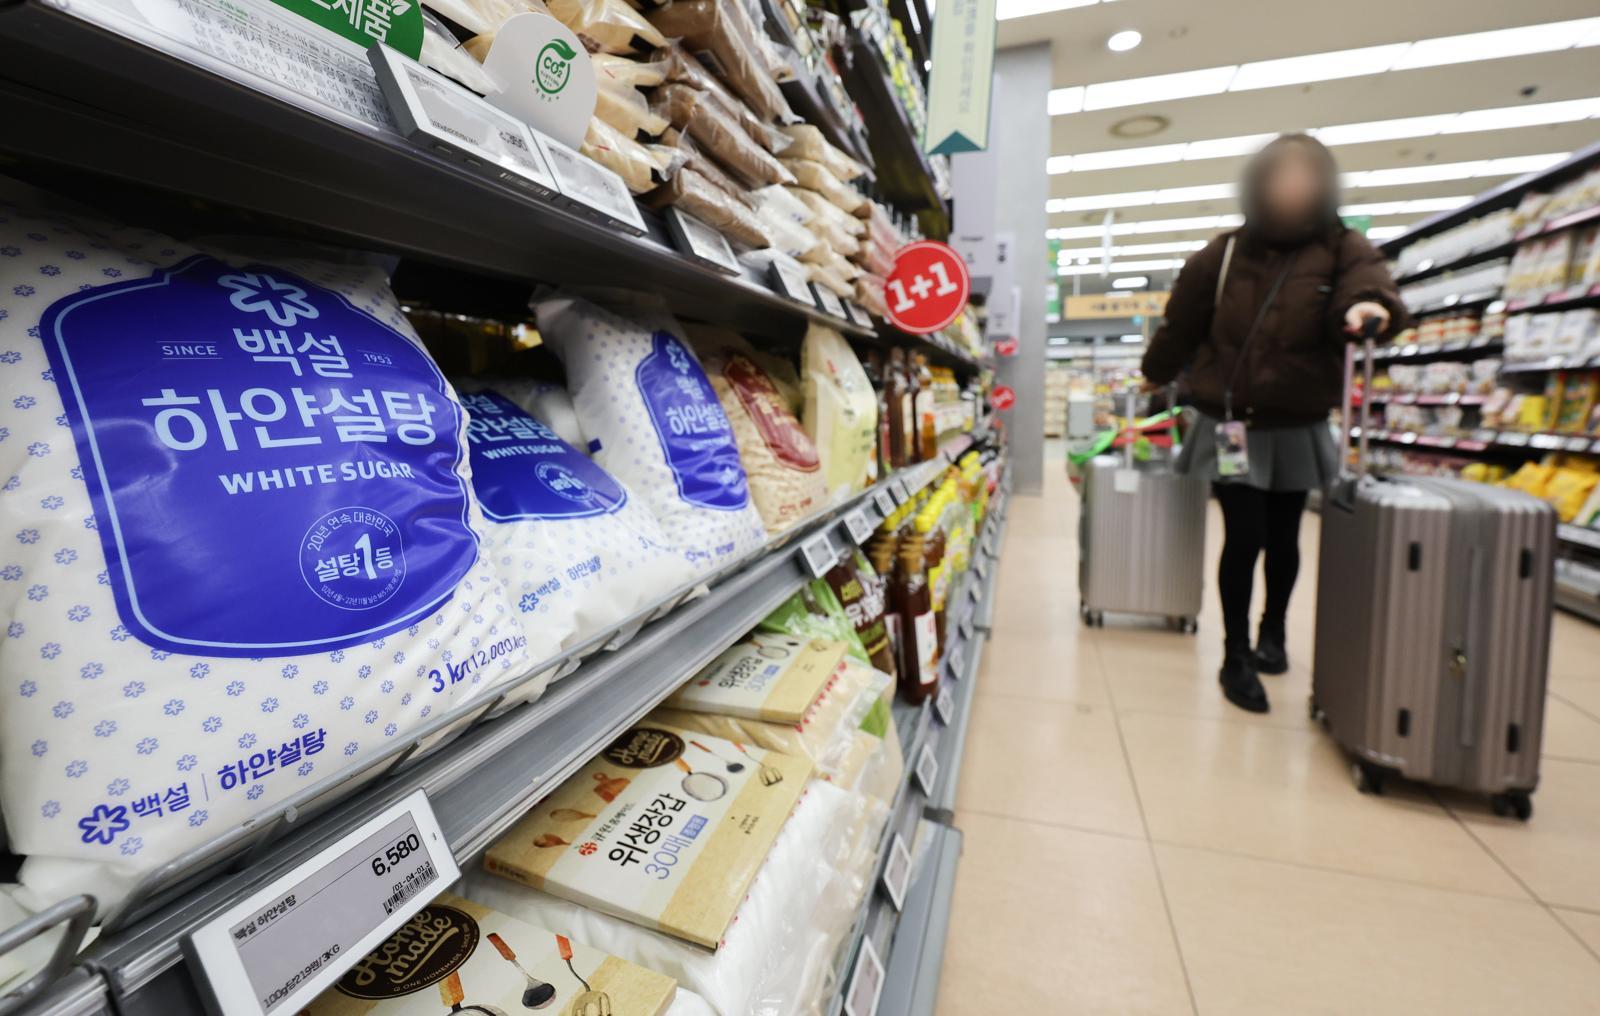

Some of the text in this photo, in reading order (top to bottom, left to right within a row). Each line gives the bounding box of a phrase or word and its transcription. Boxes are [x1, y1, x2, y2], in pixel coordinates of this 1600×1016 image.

[309, 0, 392, 43] 제품
[888, 261, 958, 313] 1+1
[162, 345, 392, 365] SINCE 1953
[232, 328, 354, 378] 백설
[142, 387, 436, 451] 하얀설탕
[219, 461, 415, 495] WHITE SUGAR
[307, 511, 394, 552] 20년 연속 대한민국
[428, 669, 445, 693] 3
[132, 728, 327, 818] 백설 하얀설탕
[608, 793, 687, 867] 위생장갑
[371, 833, 420, 877] 6,580
[645, 834, 693, 880] 30매
[257, 894, 298, 926] 하얀설탕
